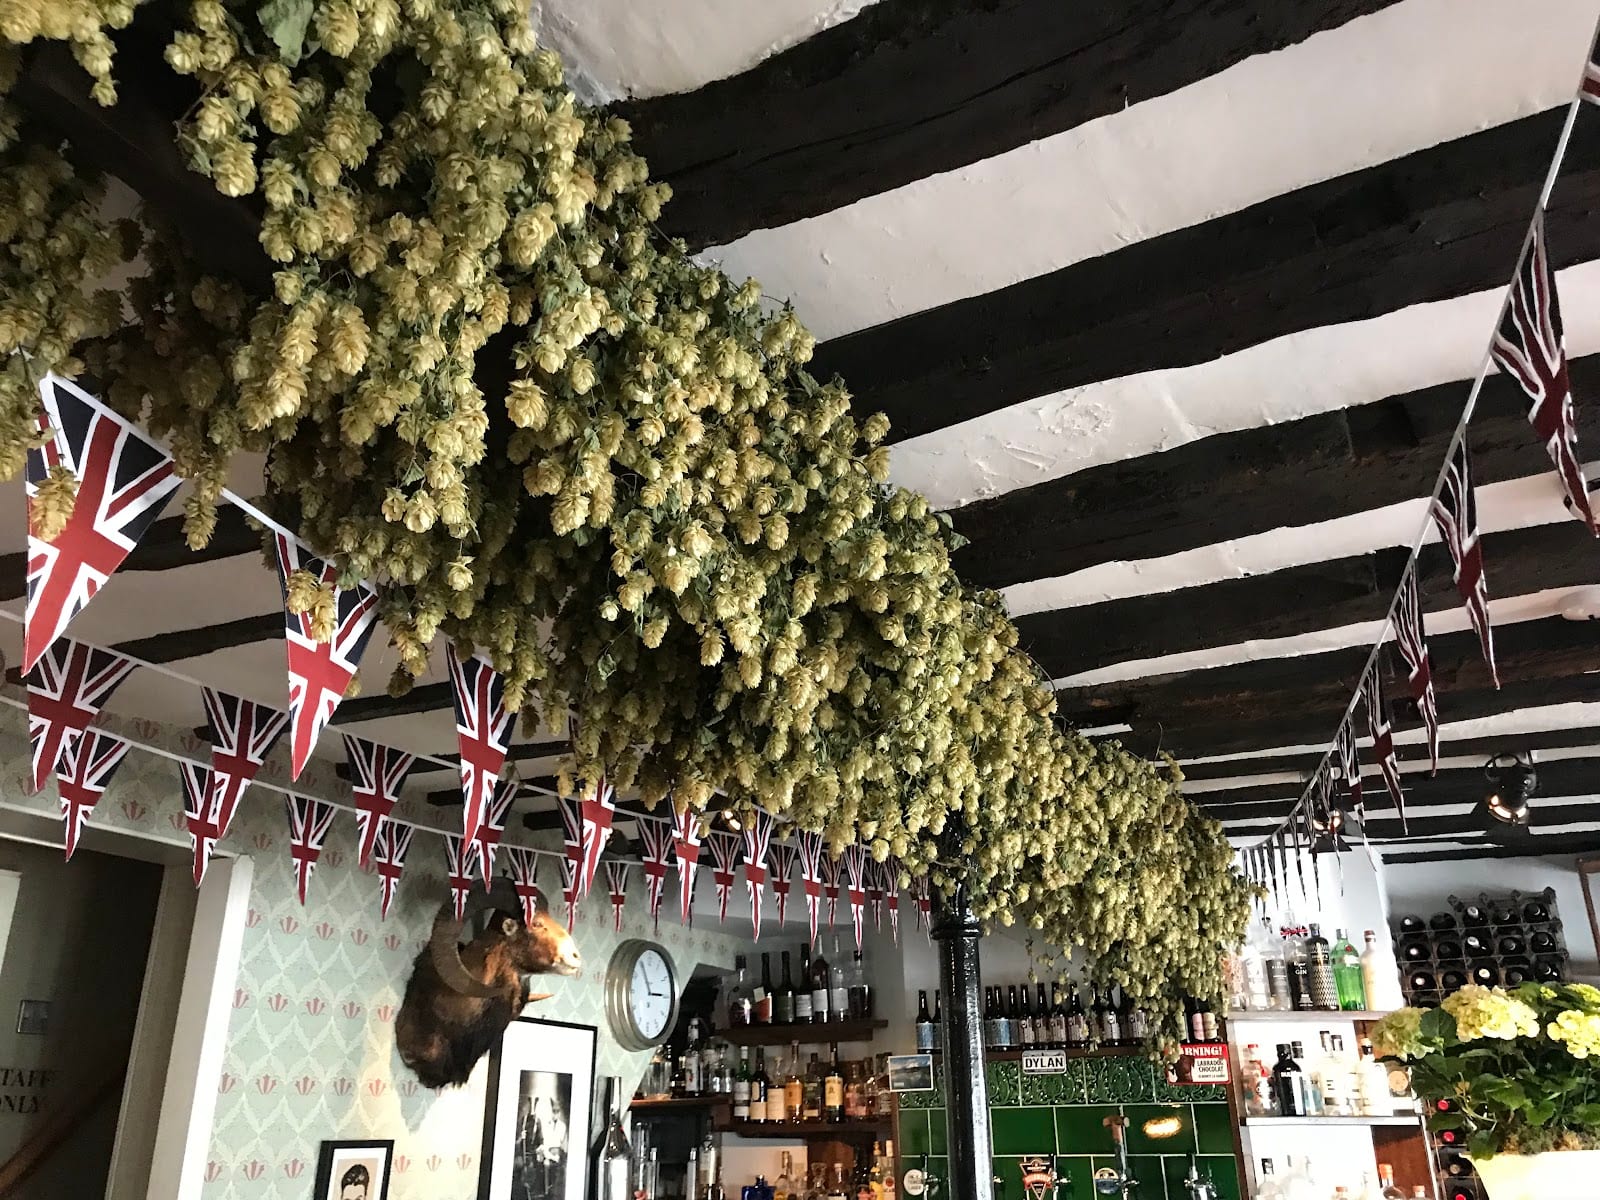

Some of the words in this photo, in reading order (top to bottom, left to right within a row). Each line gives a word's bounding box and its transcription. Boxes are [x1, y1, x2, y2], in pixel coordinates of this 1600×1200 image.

[1184, 1046, 1223, 1056] RNING!
[1025, 1057, 1064, 1067] DYLAN
[0, 1068, 55, 1088] TAFF
[0, 1095, 47, 1114] NLY
